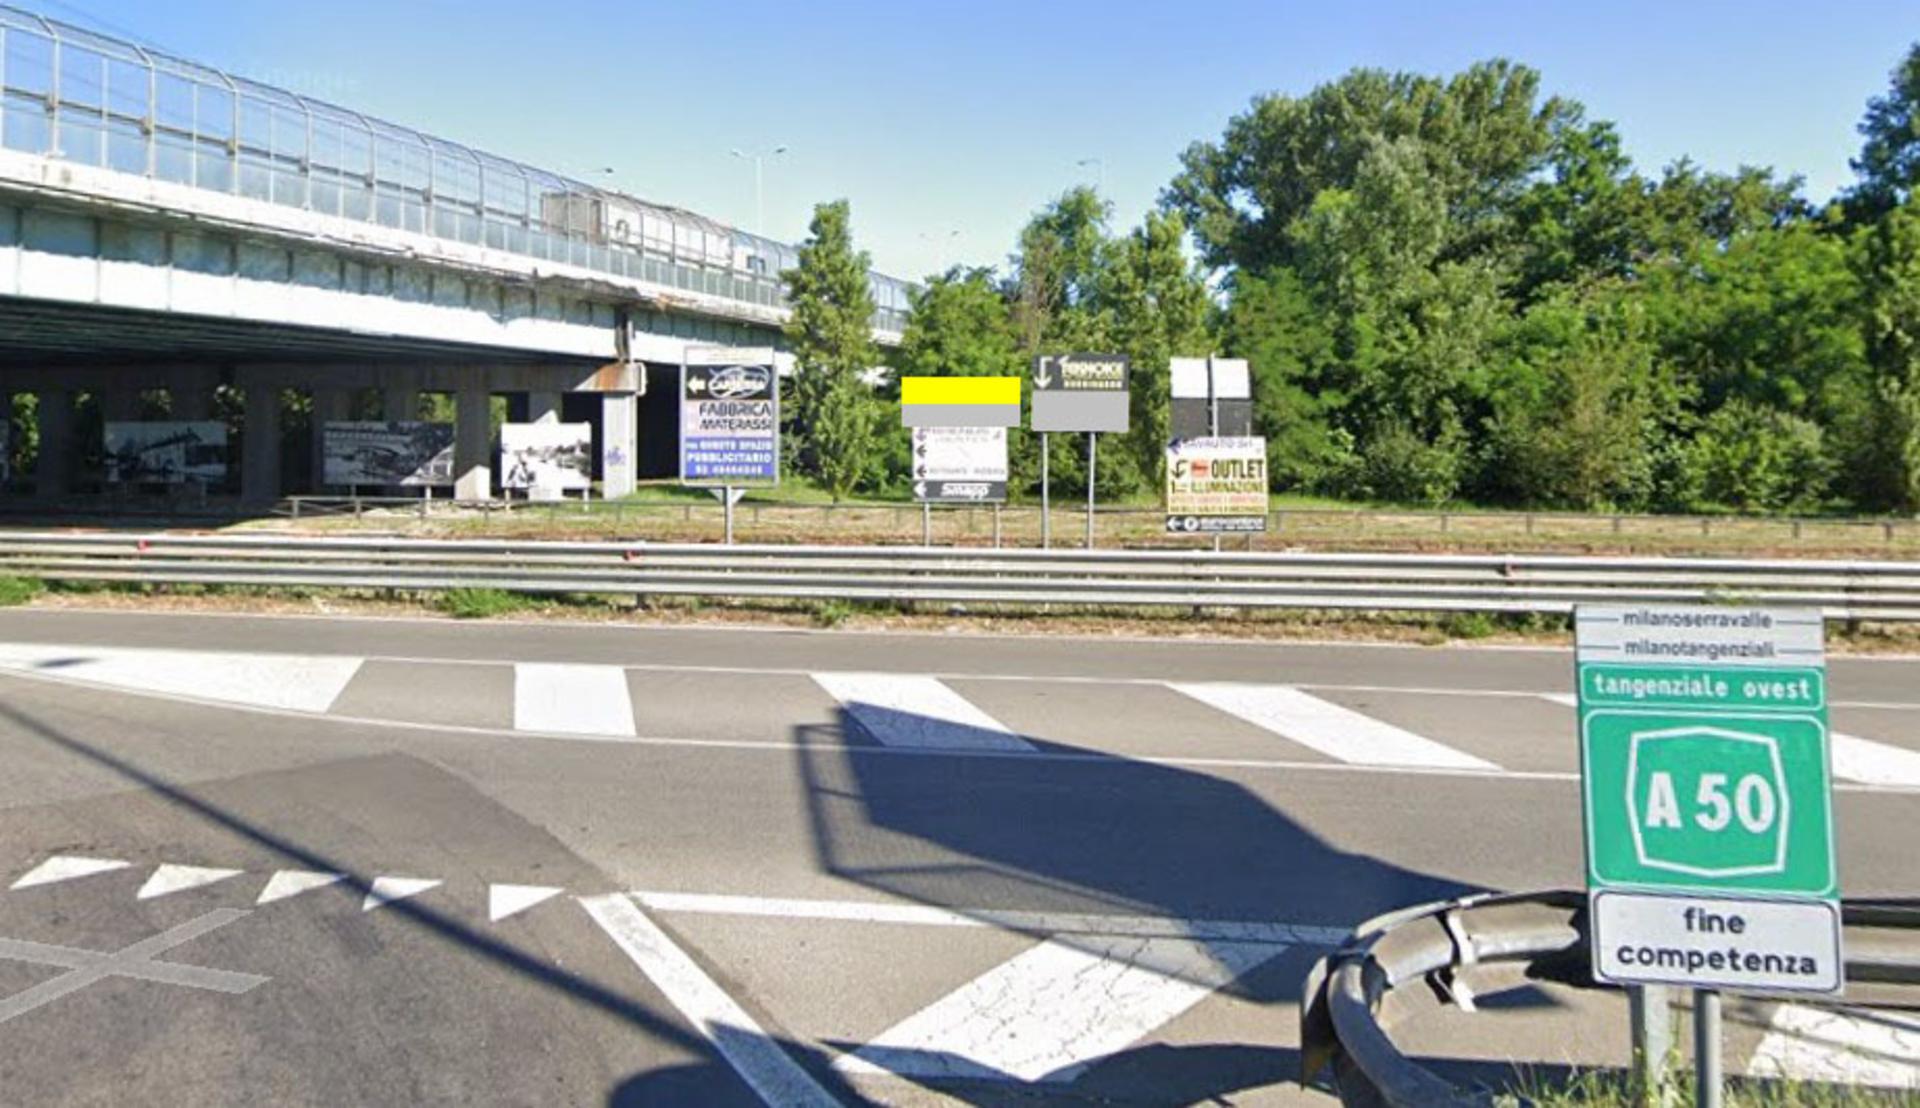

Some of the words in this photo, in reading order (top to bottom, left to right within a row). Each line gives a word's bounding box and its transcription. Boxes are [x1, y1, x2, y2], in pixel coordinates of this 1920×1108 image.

[699, 402, 771, 417] FABBRICA
[1212, 459, 1264, 479] OUTLET
[1623, 610, 1772, 628] milanoserravalle
[1625, 639, 1775, 660] milanotangenziali
[1594, 673, 1729, 698] tangenziale
[1742, 679, 1812, 699] ovest
[1645, 772, 1682, 829] A
[1695, 773, 1776, 834] 50
[1683, 906, 1746, 934] fine
[1616, 945, 1818, 975] competenza
